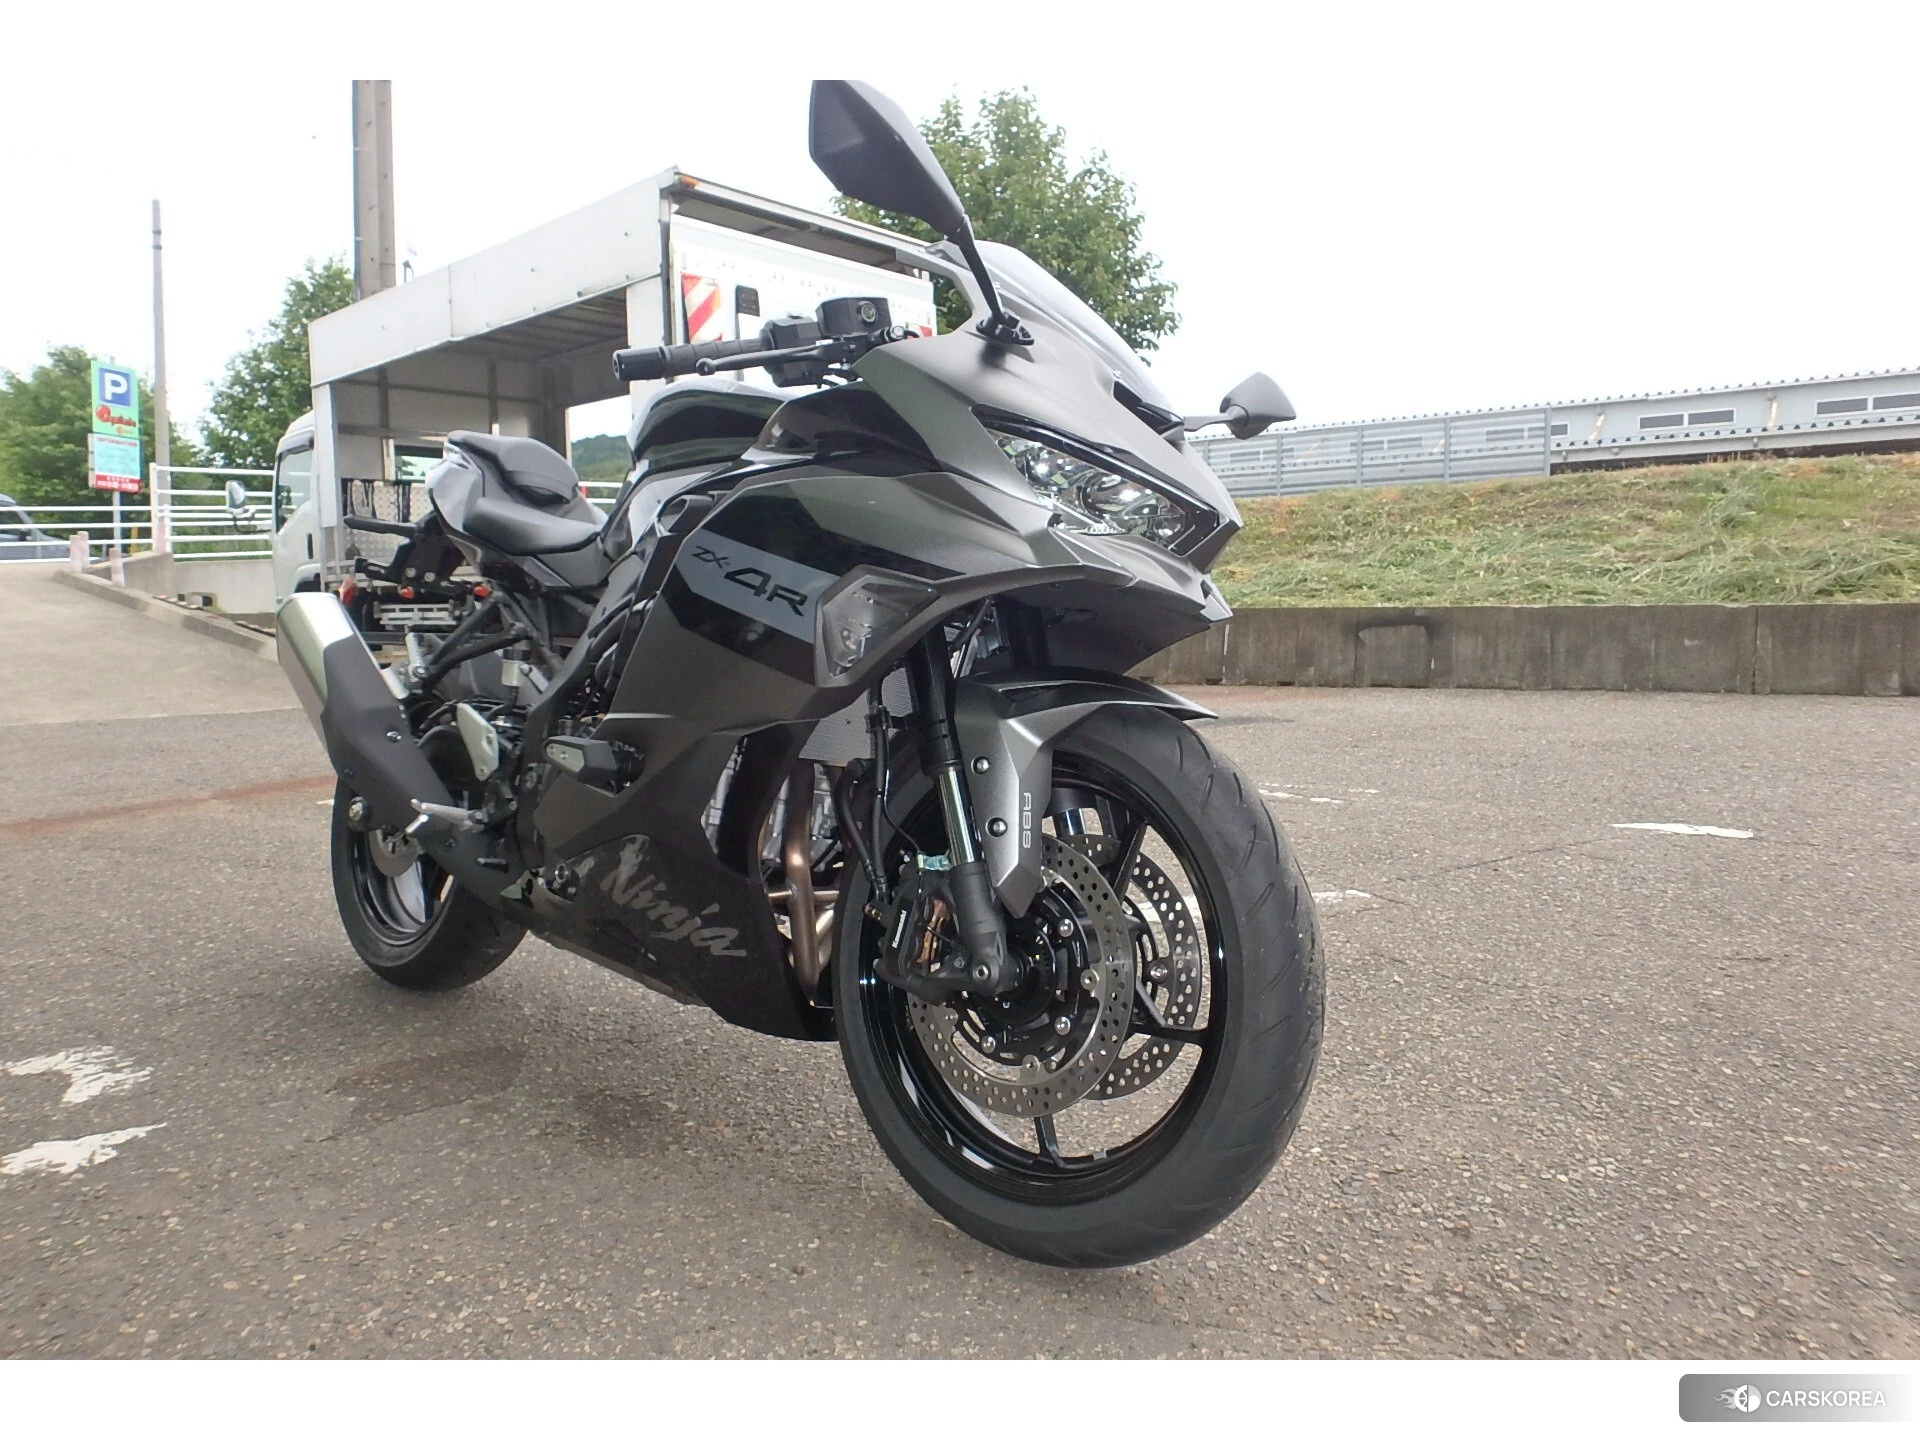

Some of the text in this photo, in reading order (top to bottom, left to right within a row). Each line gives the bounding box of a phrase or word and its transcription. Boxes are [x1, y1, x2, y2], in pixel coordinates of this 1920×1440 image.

[104, 372, 128, 401] P
[1022, 792, 1032, 849] ABS
[573, 834, 748, 957] Ninja
